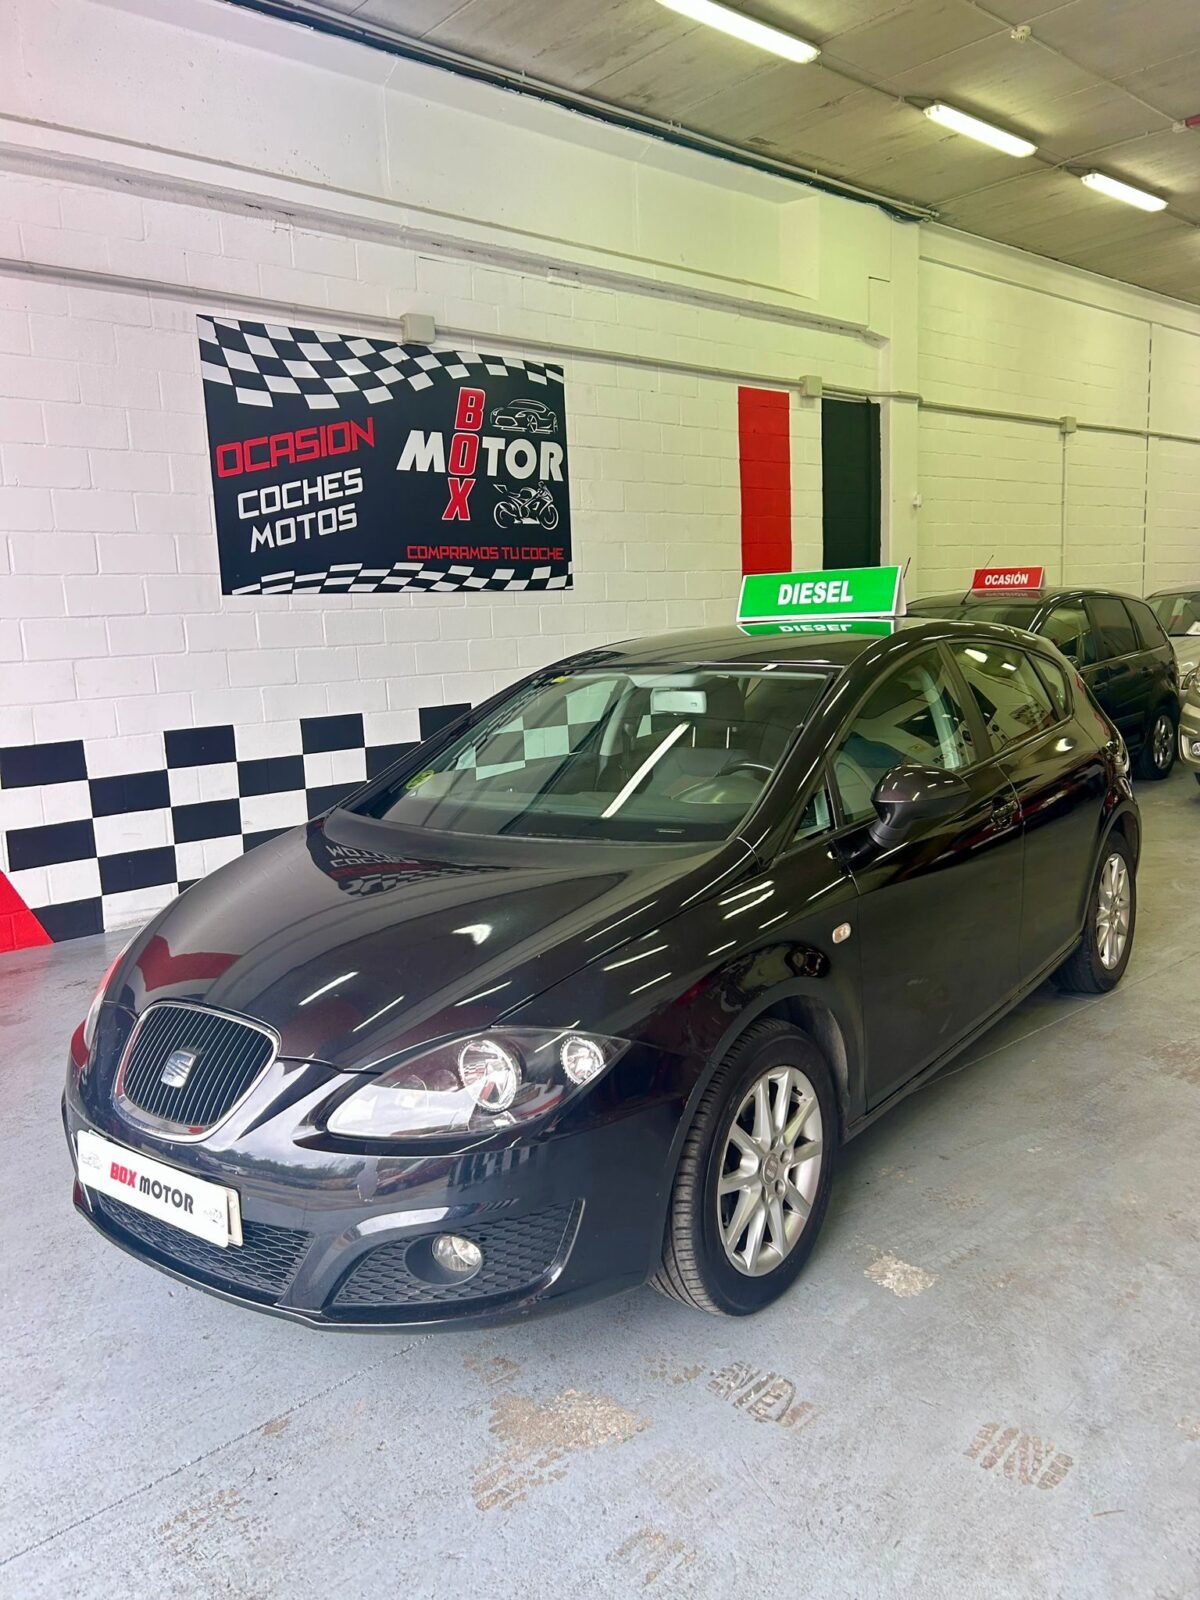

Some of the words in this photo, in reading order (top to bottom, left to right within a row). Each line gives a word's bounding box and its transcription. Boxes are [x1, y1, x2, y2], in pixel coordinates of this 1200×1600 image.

[215, 416, 375, 478] OCASION
[396, 429, 564, 482] MOTOR
[441, 386, 486, 521] BOX
[237, 467, 363, 520] COCHES
[250, 502, 358, 553] MOTOS
[406, 545, 499, 560] COMPRAMOS
[501, 546, 520, 560] TU
[521, 547, 565, 560] COCHE
[777, 580, 853, 606] DIESEL
[984, 571, 1029, 586] OCASIÓN
[111, 1162, 137, 1188] BOX
[139, 1176, 194, 1214] MOTOR
